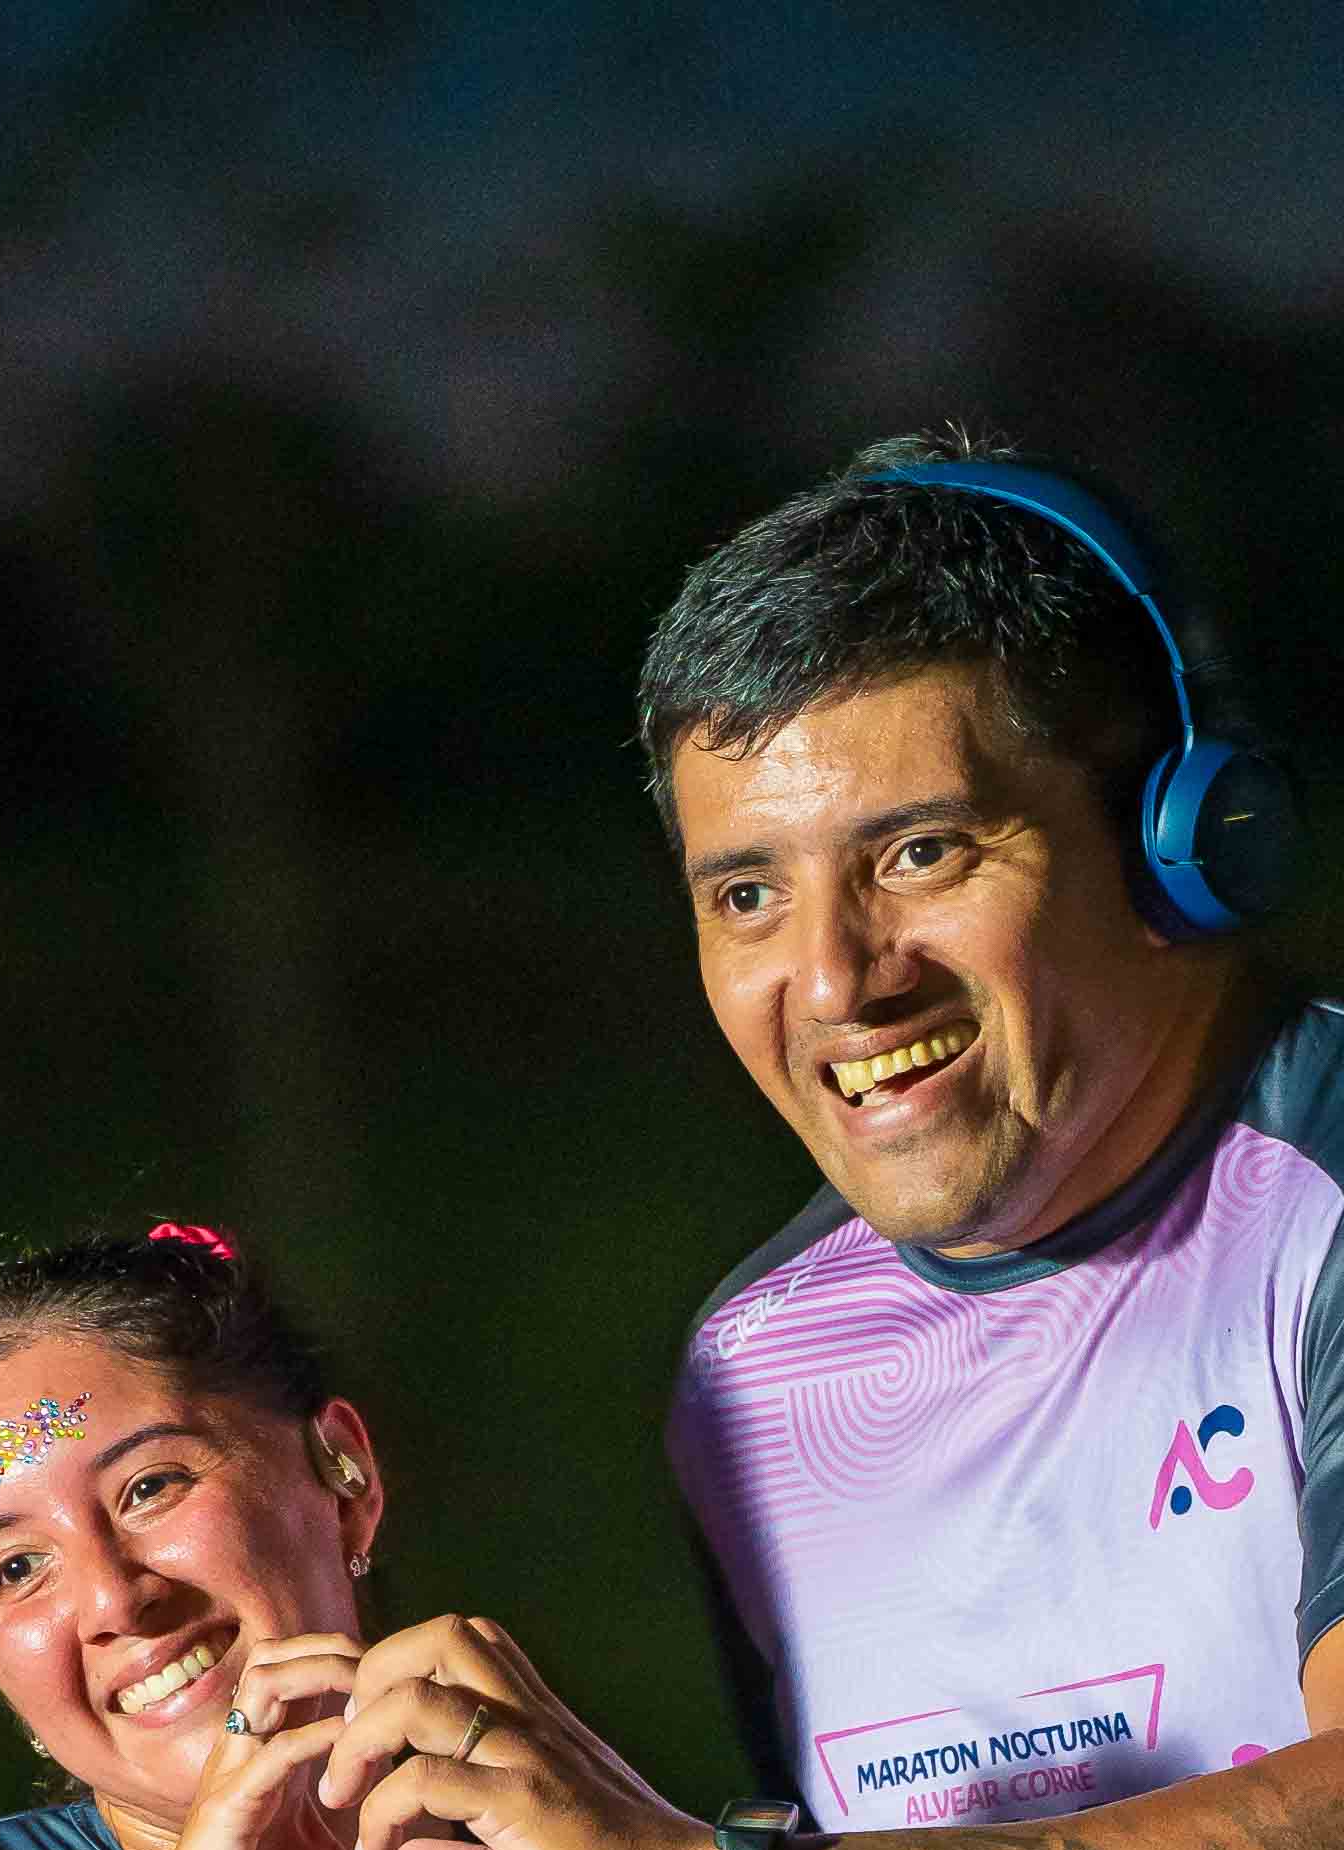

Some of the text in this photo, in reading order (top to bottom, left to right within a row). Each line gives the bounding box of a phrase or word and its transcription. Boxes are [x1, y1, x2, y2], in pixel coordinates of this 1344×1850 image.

[856, 1711, 1133, 1794] MARATON NOCTURNA
[905, 1760, 1098, 1825] ALVEAR CORRE
